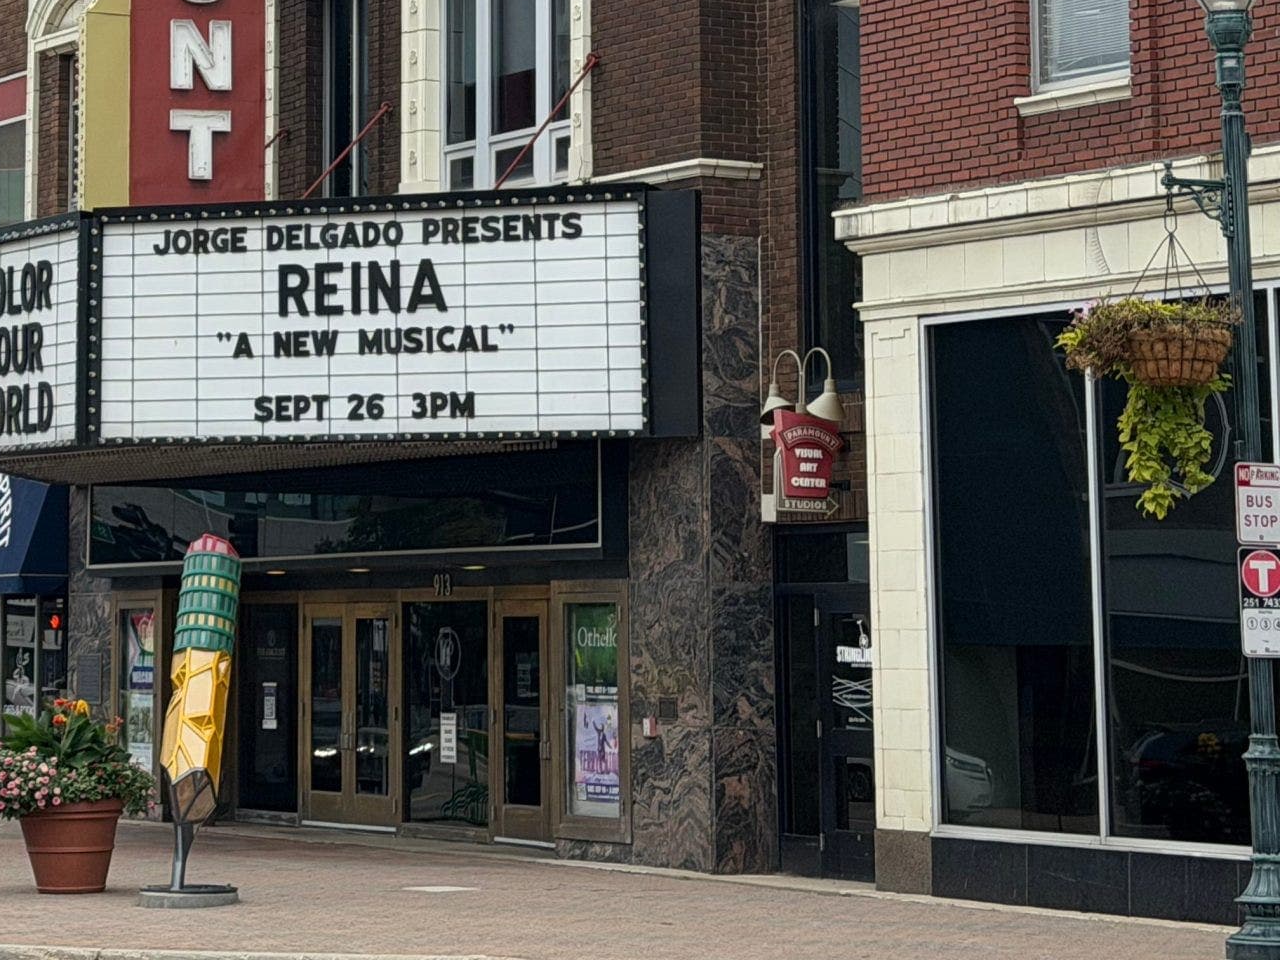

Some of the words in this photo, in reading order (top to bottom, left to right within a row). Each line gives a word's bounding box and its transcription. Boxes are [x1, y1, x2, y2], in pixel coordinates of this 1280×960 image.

[152, 226, 248, 256] JORGE
[265, 219, 404, 252] DELGADO
[421, 212, 583, 245] PRESENTS
[277, 258, 449, 318] REINA
[216, 331, 254, 359] "A
[272, 329, 339, 358] NEW
[357, 323, 516, 356] MUSICAL"
[253, 394, 330, 422] SEPT
[346, 393, 385, 421] 26
[410, 391, 476, 419] 3PM
[786, 428, 836, 446] PARAMOUNT
[794, 447, 824, 460] VISUAL
[799, 462, 819, 473] ART
[1238, 467, 1249, 481] NO
[790, 476, 827, 489] CENTER
[784, 499, 827, 510] STUDIOS
[1246, 494, 1273, 509] BUS
[1243, 513, 1279, 528] STOP
[1249, 559, 1277, 593] T
[433, 573, 451, 597] 913
[1243, 596, 1260, 608] 251
[1263, 596, 1280, 608] 743
